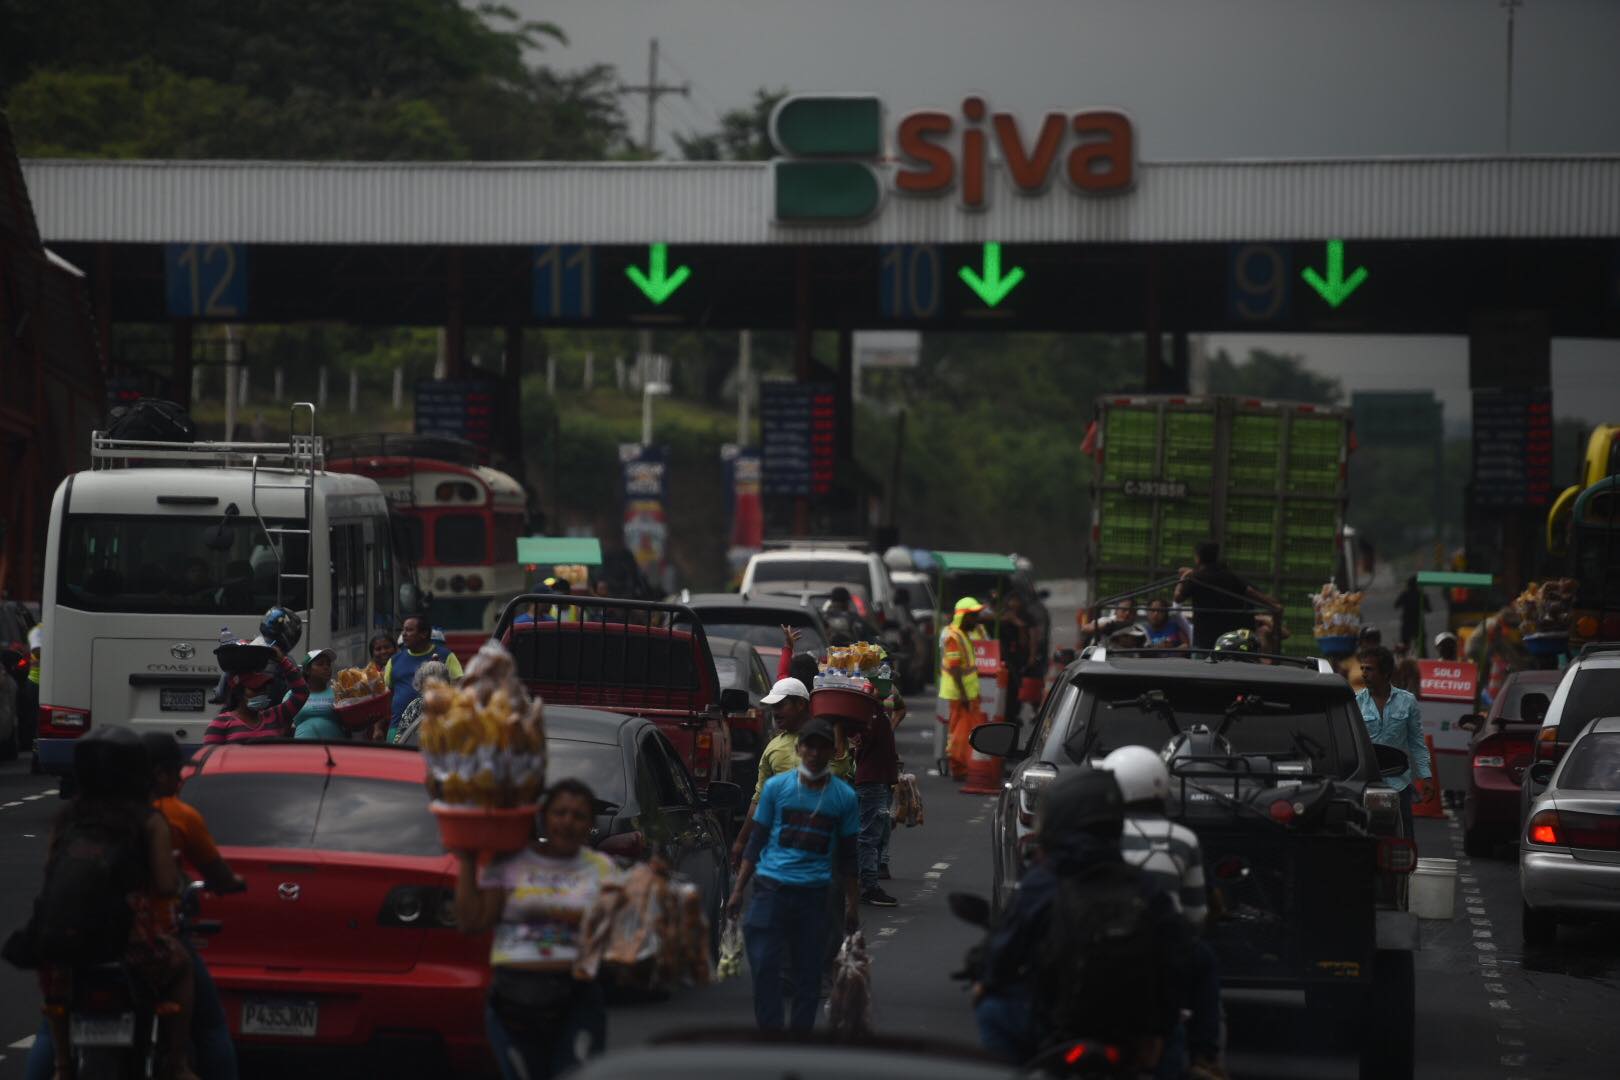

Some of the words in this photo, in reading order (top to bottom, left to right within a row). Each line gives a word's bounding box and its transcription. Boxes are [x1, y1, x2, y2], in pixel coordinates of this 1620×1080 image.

[177, 244, 238, 317] 12
[531, 246, 594, 318] 11
[881, 245, 942, 319] 10
[1234, 244, 1286, 321] 9
[147, 663, 218, 672] COASTER
[1420, 679, 1471, 691] EFECTIVO
[1433, 667, 1461, 678] SOLO
